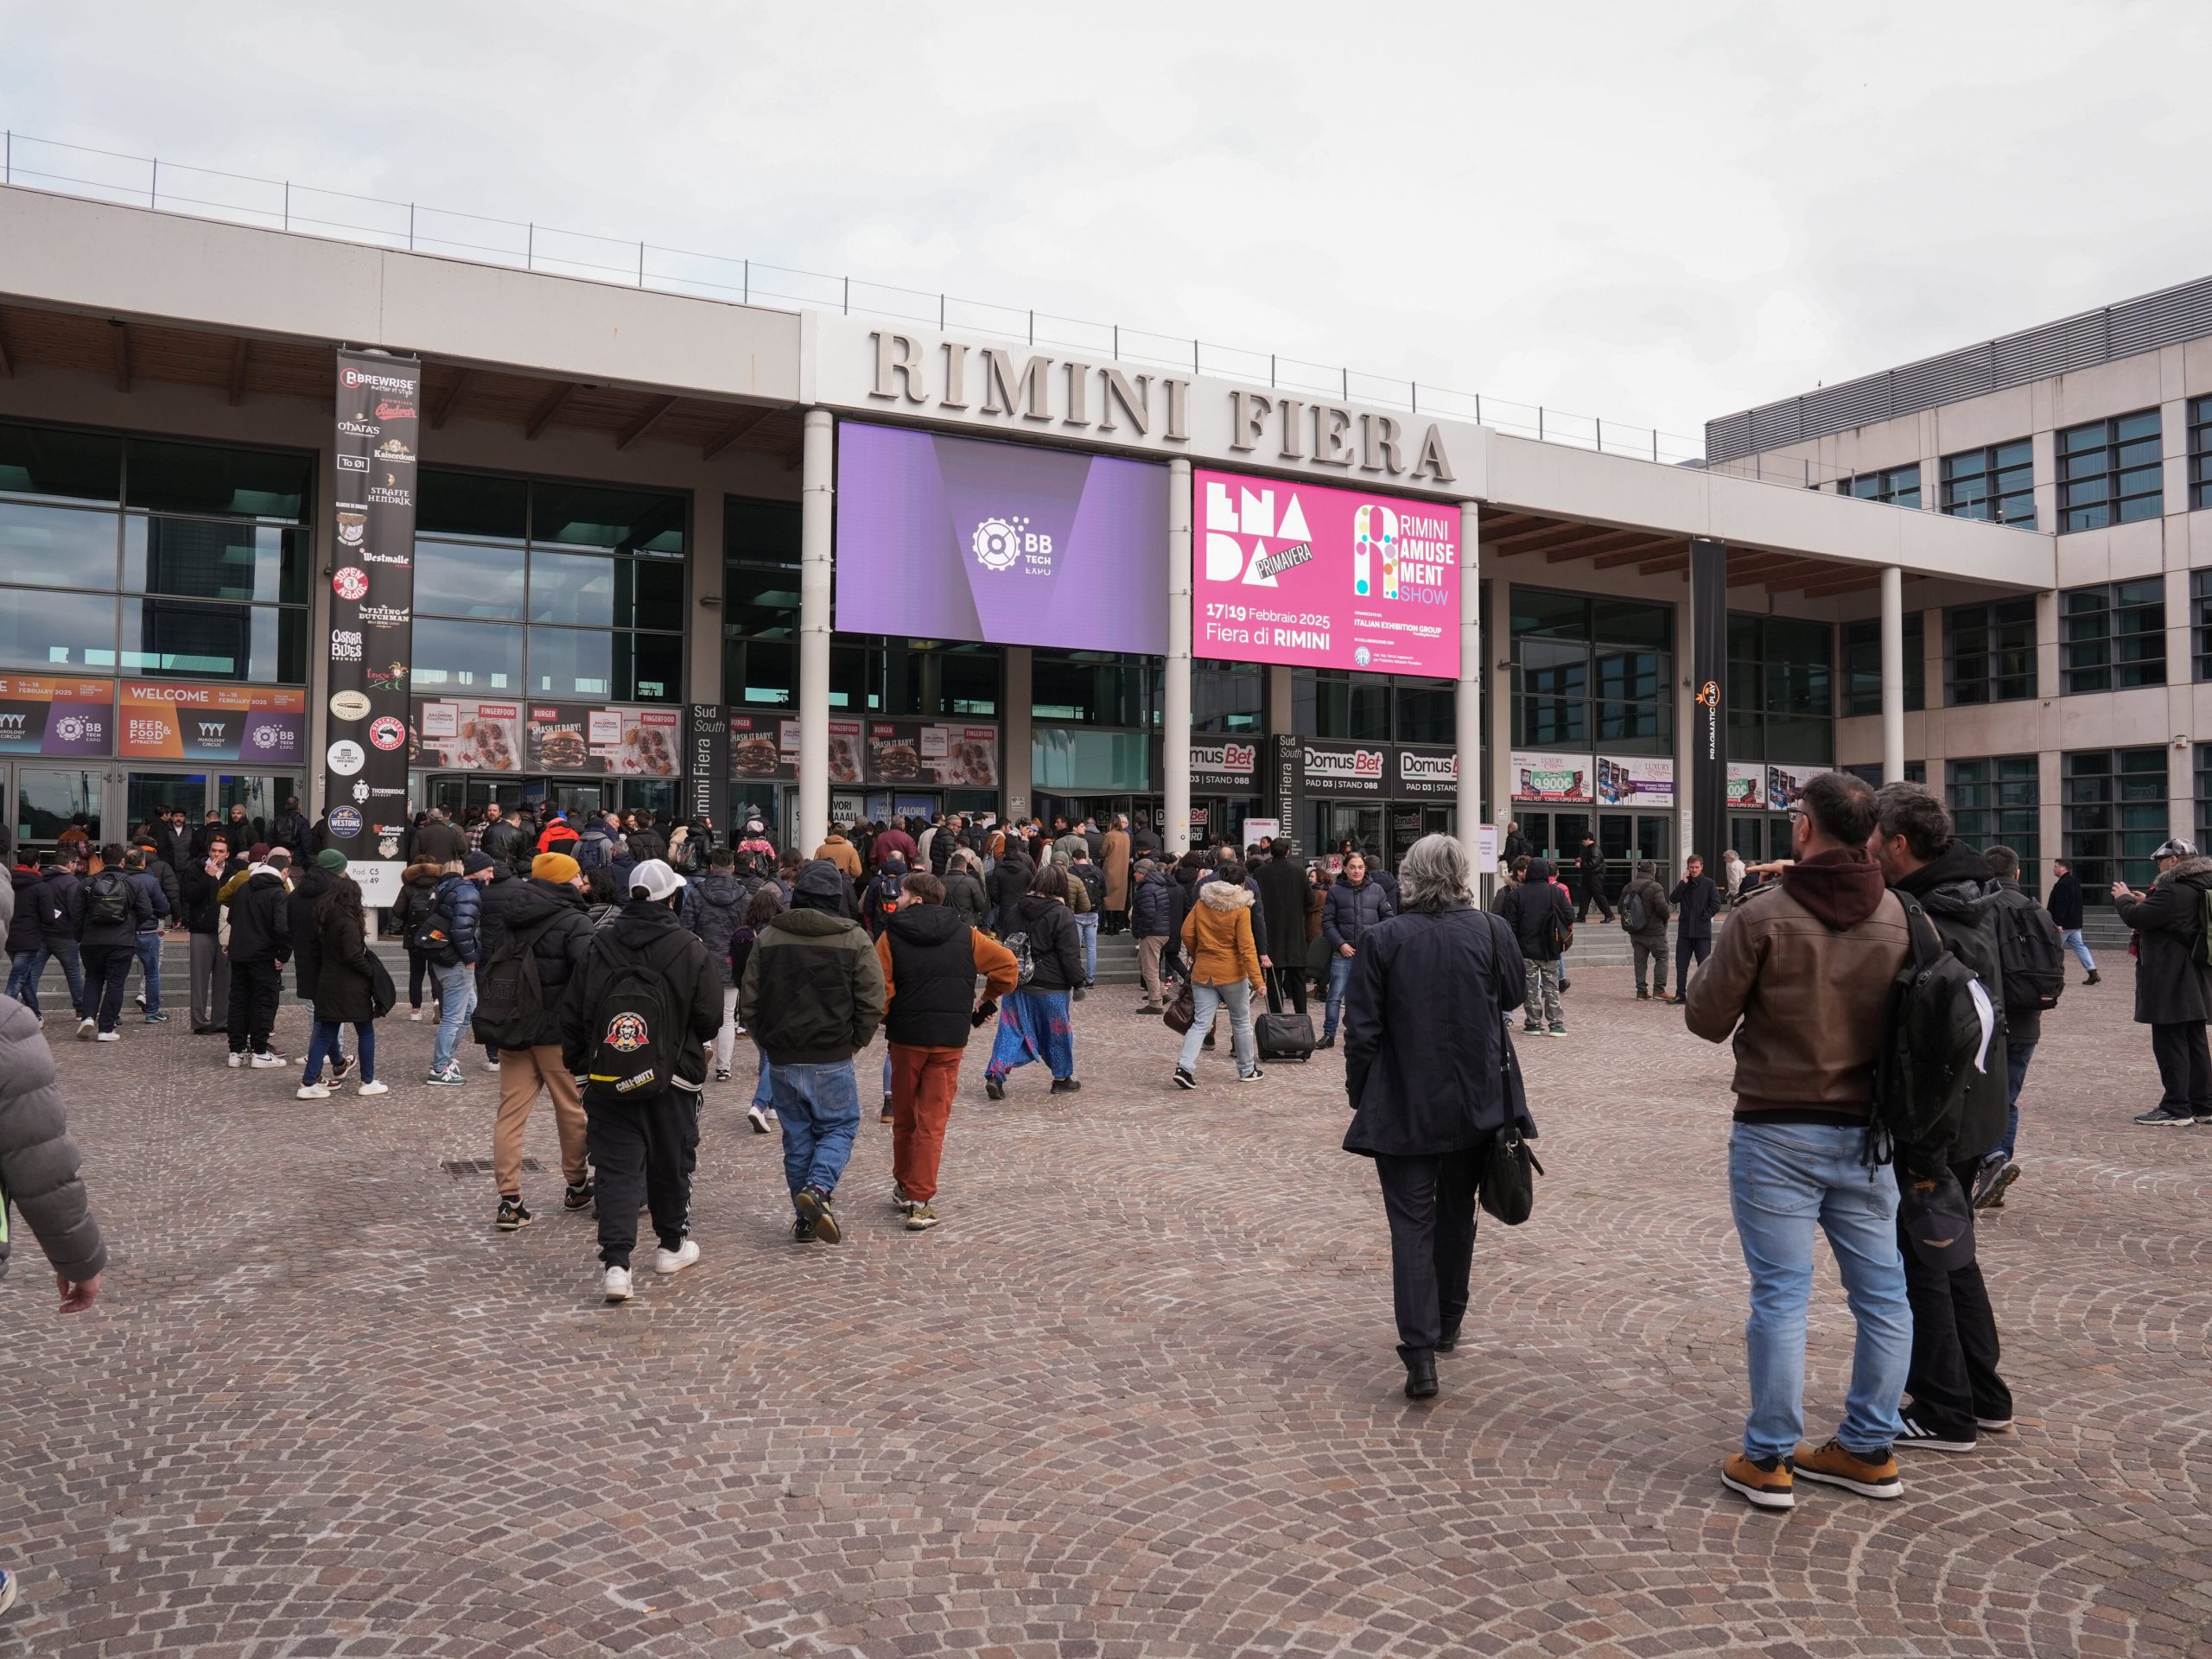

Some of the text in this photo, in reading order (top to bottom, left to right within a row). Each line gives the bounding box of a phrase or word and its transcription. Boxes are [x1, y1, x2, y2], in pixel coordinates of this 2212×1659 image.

[358, 374, 414, 390] BREWRISE
[869, 330, 1457, 482] RIMINI FIERA
[374, 449, 416, 461] Kaiserdom
[372, 487, 410, 497] STRAFFE
[368, 495, 412, 505] HENDRIK
[1401, 514, 1448, 541] RIMINI
[1026, 533, 1052, 554] BB
[1401, 538, 1454, 564] AMUSE
[364, 552, 410, 564] Westmalle
[1026, 555, 1052, 565] TECH
[1256, 542, 1313, 579] PRIMAVERA
[334, 567, 365, 583] JOPEN
[1401, 562, 1444, 586] MENT
[1401, 586, 1448, 606] SHOW
[359, 613, 410, 622] DUTCHMAN
[1249, 607, 1297, 624] Febbraio
[1300, 613, 1331, 629] 2025
[1354, 619, 1442, 634] ITALIAN EXHIBITION GROUP
[332, 629, 362, 645] OSKAR
[1206, 622, 1331, 651] Fiera di RIMINI
[332, 643, 362, 657] BLUES
[131, 687, 209, 702] WELCOME
[694, 705, 716, 718] Sud
[130, 719, 162, 730] BEER
[643, 715, 675, 723] FINGERFOOD
[86, 723, 102, 733] BB
[531, 723, 582, 734] SMASH IT BABY!
[694, 720, 725, 733] South
[130, 729, 163, 740] FOOD
[280, 731, 295, 741] BB
[755, 732, 773, 741] BABY!
[1280, 735, 1295, 746] Sud
[873, 741, 891, 749] SMASH
[898, 738, 914, 747] BABY!
[693, 739, 710, 776] Fiera
[1190, 747, 1252, 765] musBet
[1280, 747, 1302, 758] South
[1280, 763, 1292, 794] Fiera
[1534, 777, 1572, 790] 9.900€
[693, 779, 710, 818] imini
[898, 806, 926, 816] CALORIE
[1280, 798, 1292, 838] Rimini
